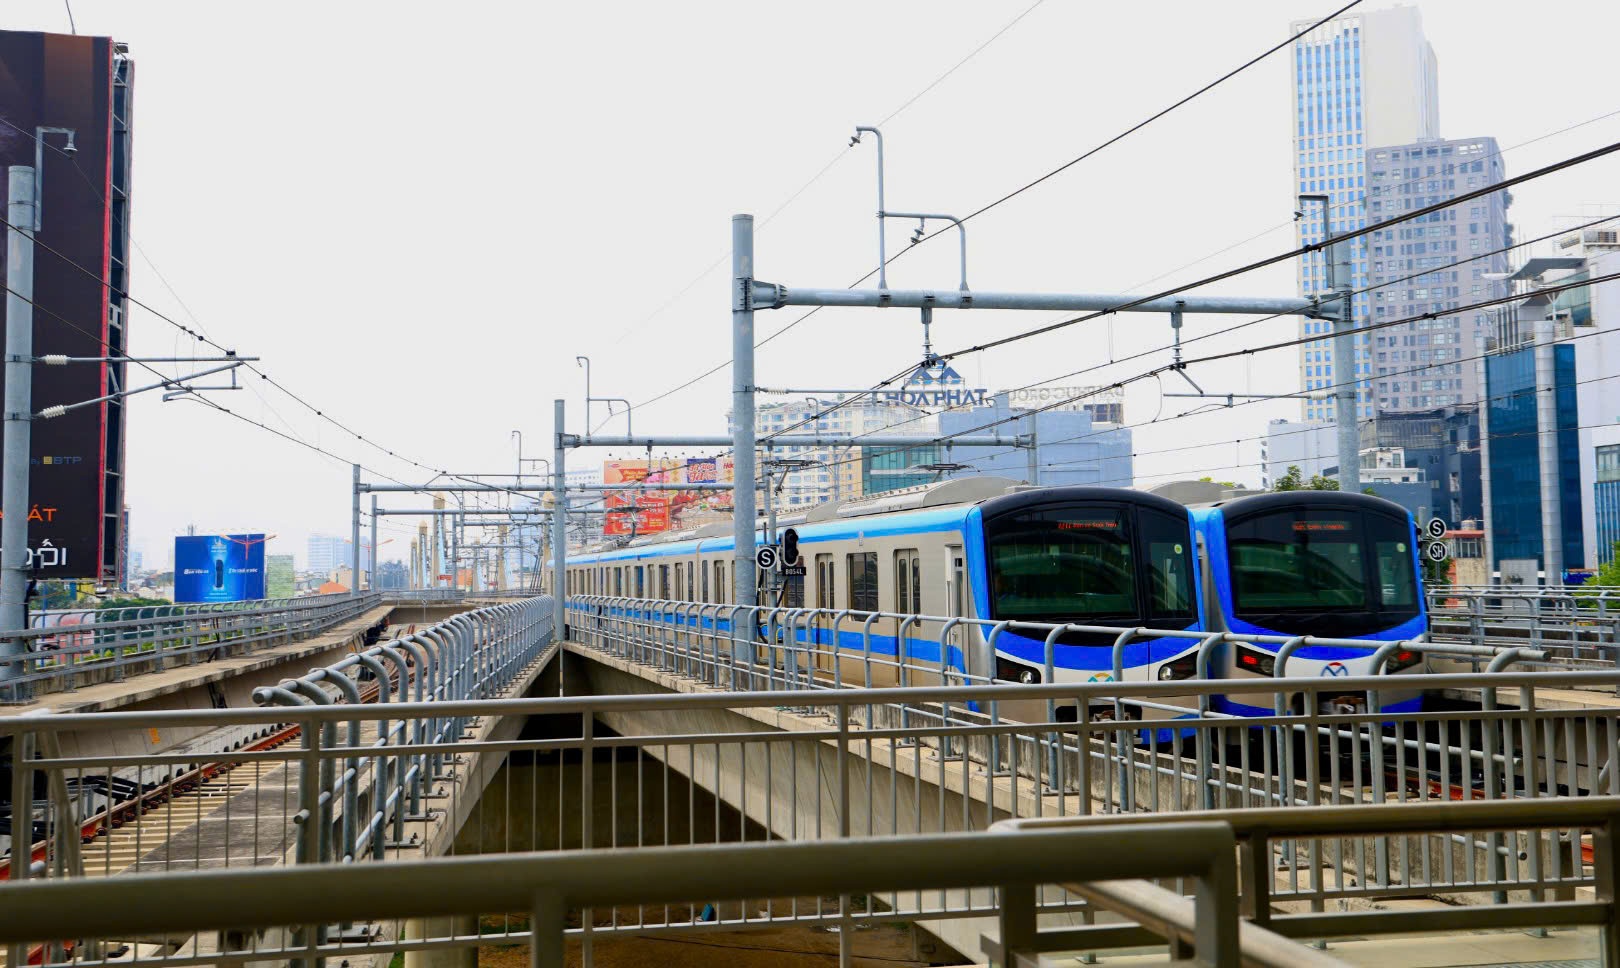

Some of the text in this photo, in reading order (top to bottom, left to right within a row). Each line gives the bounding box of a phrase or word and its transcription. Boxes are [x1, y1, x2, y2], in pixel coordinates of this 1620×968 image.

[1432, 521, 1442, 535] S
[761, 551, 771, 565] S
[1432, 544, 1444, 558] SH
